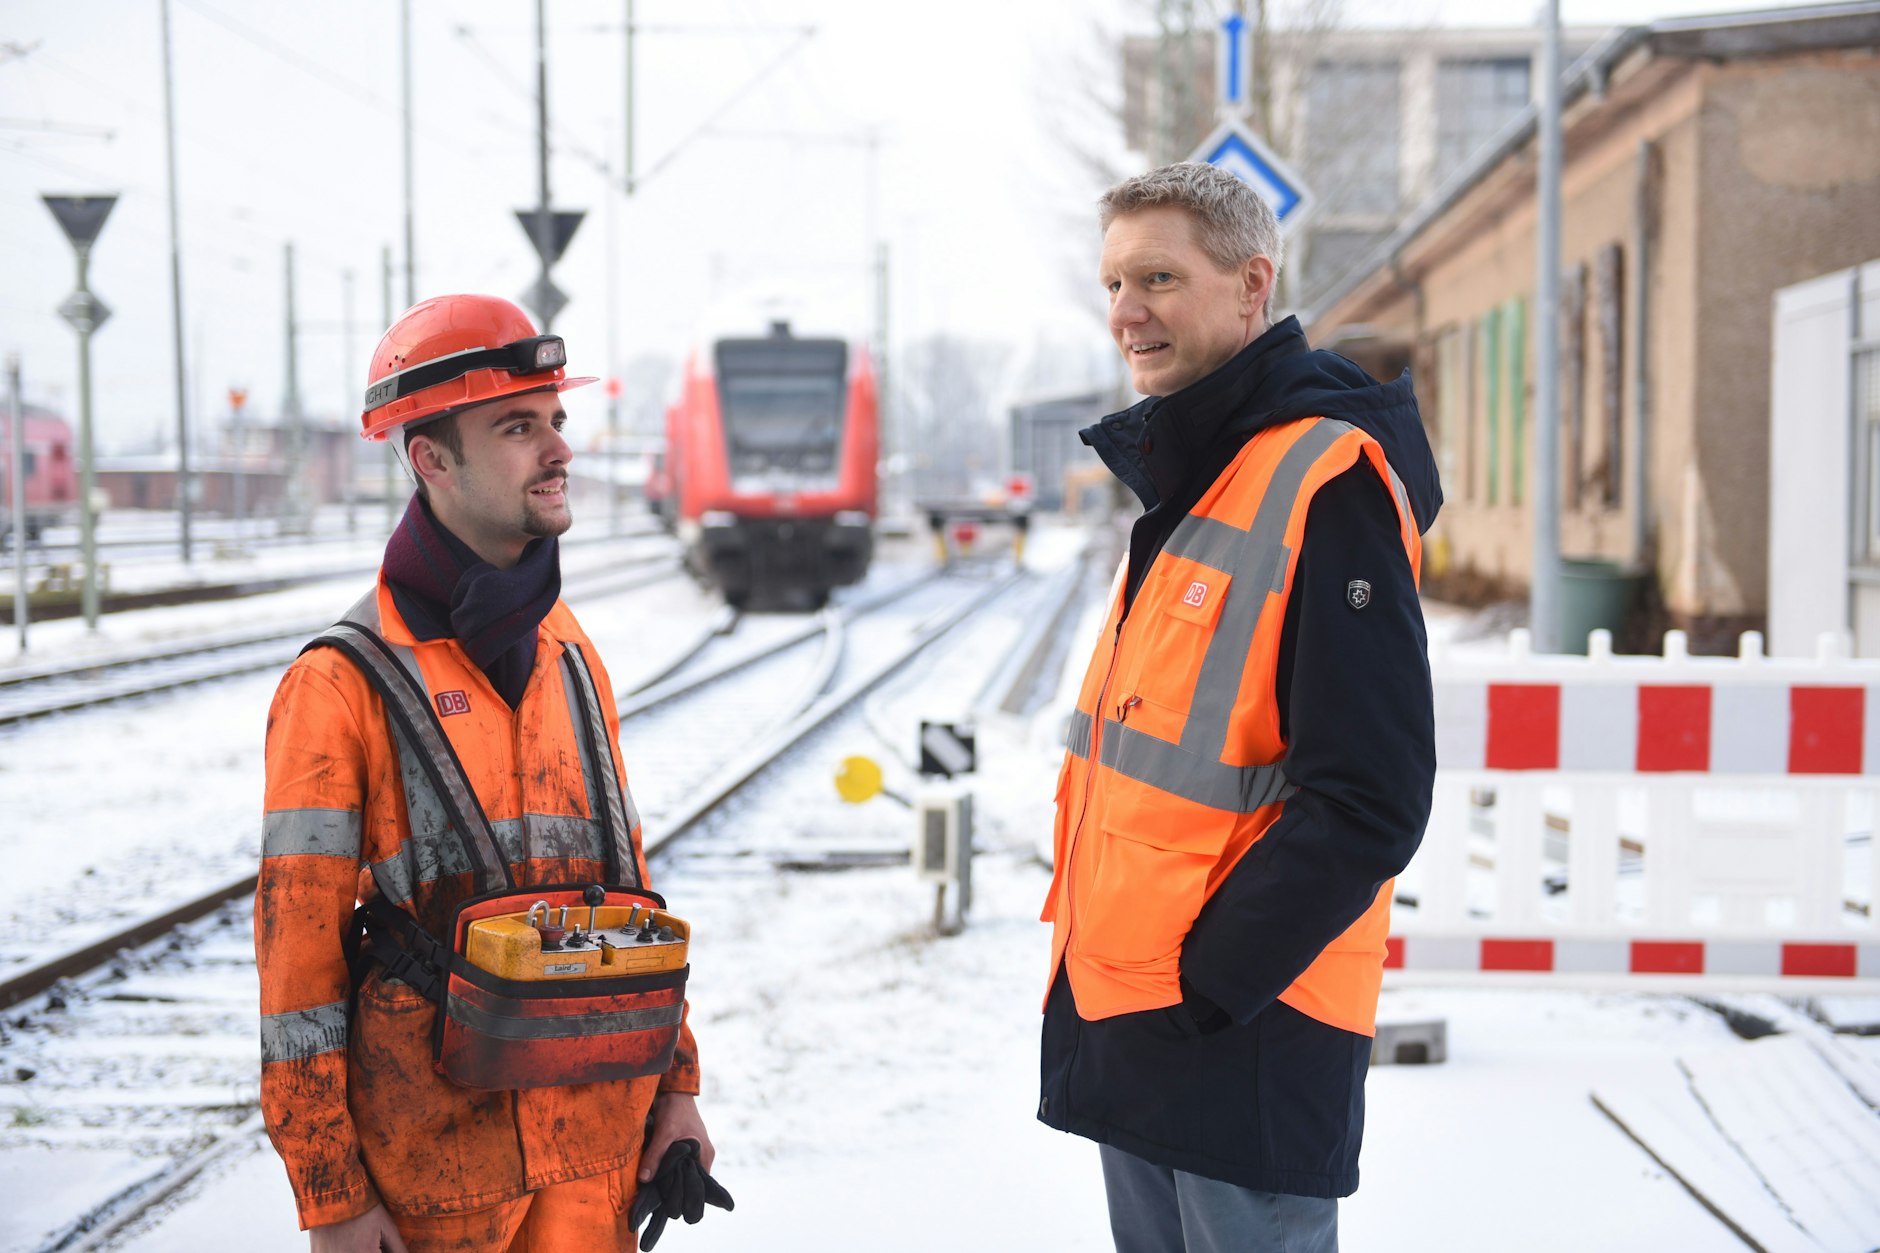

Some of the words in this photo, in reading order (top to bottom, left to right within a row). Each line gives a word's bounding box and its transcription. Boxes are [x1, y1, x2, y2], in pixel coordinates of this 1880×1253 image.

[1185, 583, 1206, 605] DB
[438, 692, 467, 714] DB
[554, 963, 572, 972] Laird
